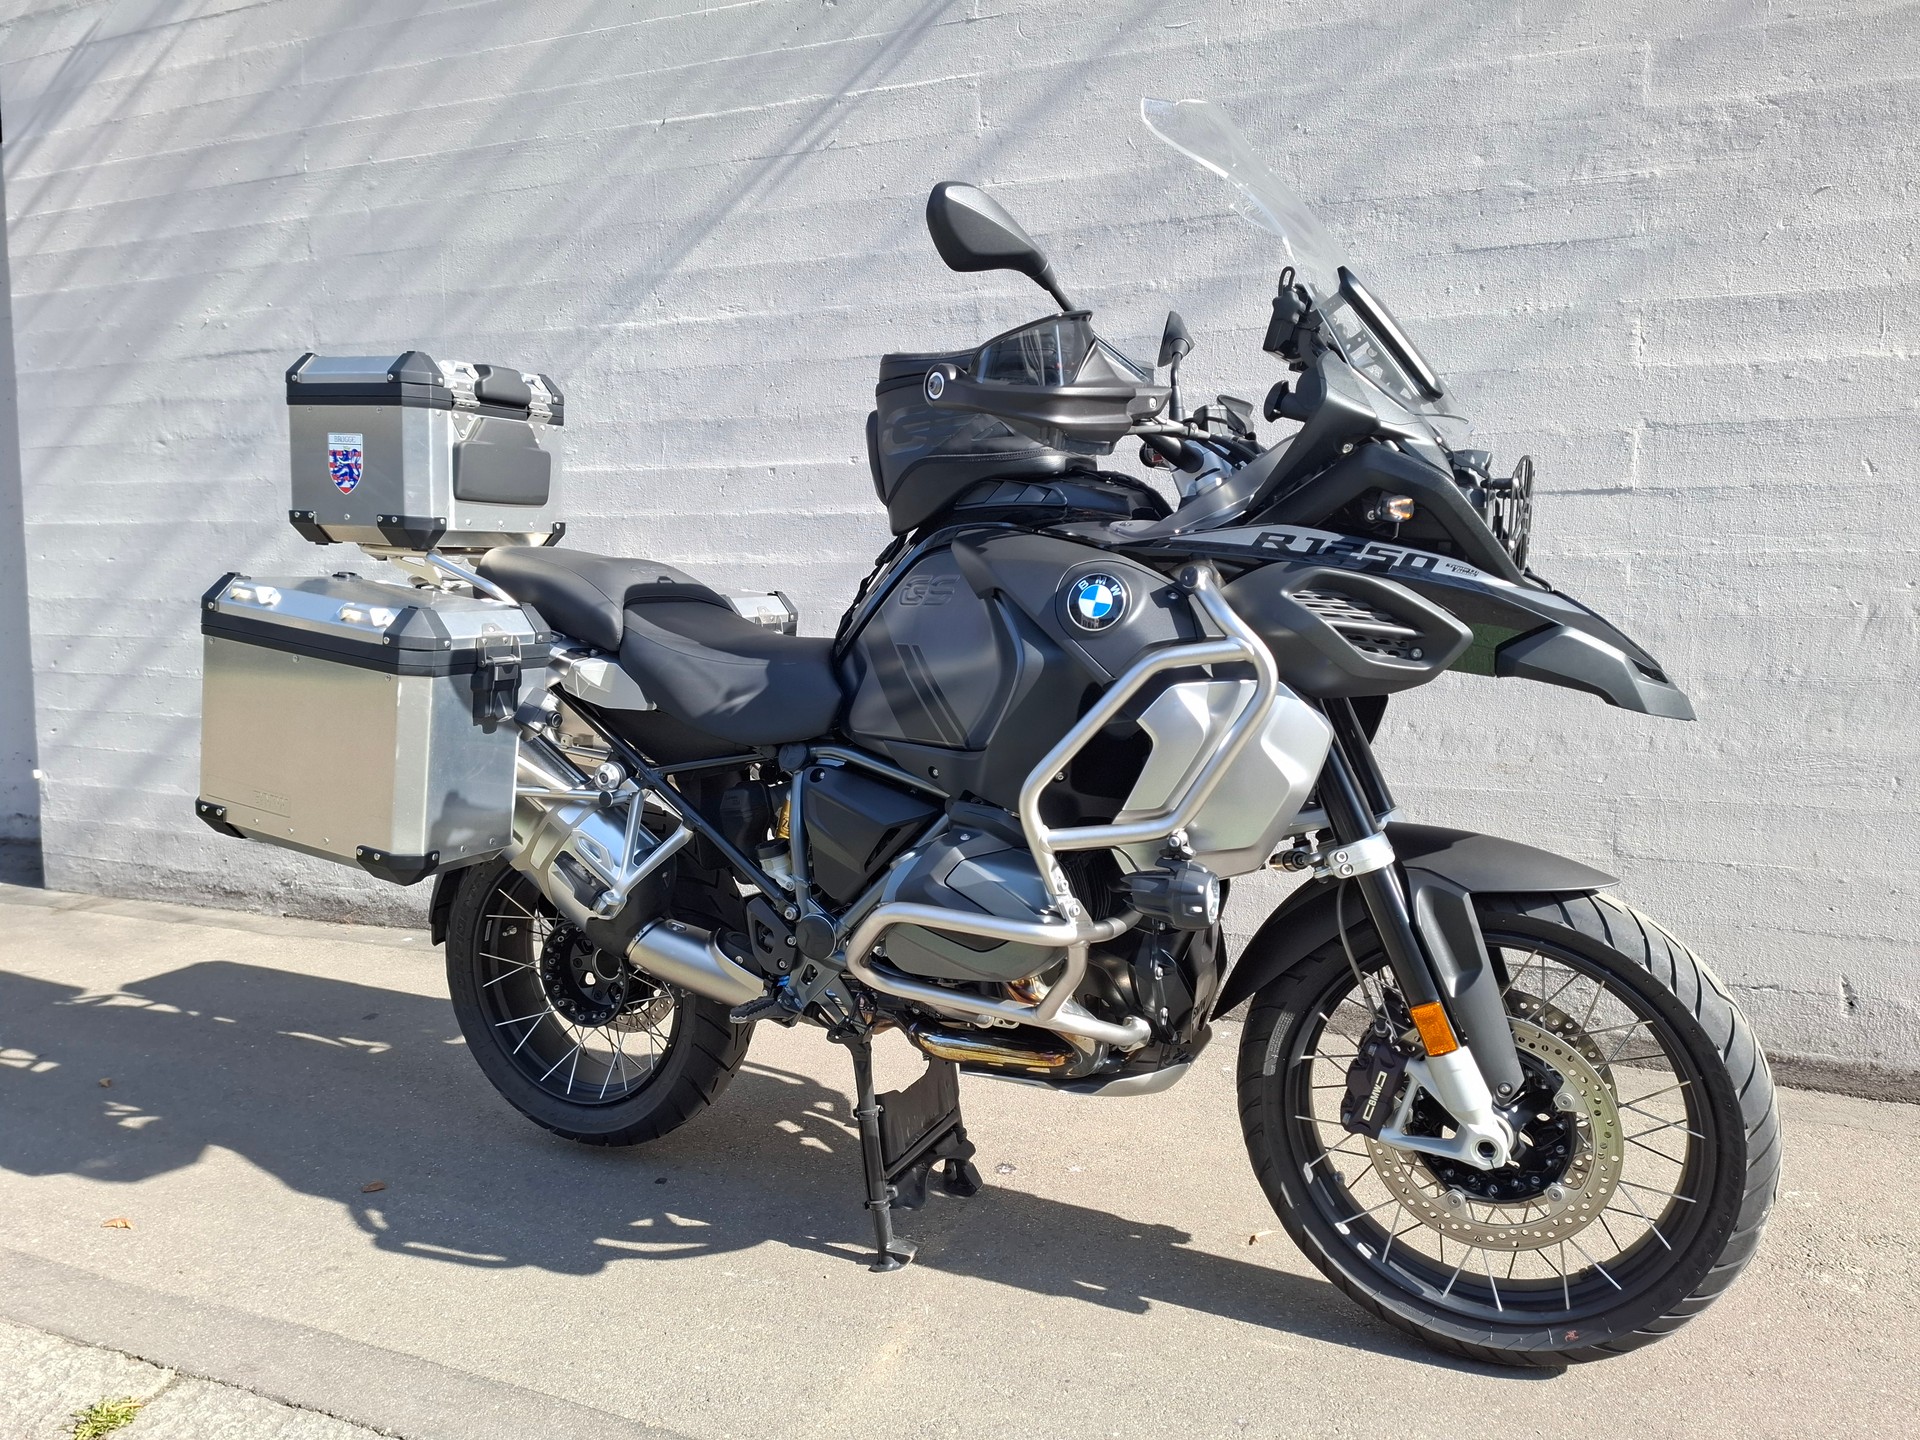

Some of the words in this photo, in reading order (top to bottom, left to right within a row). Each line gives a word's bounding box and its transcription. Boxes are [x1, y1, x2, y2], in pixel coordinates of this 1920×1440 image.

[898, 575, 960, 607] GS
[1077, 576, 1121, 596] BMW
[1368, 1083, 1383, 1107] BMW
